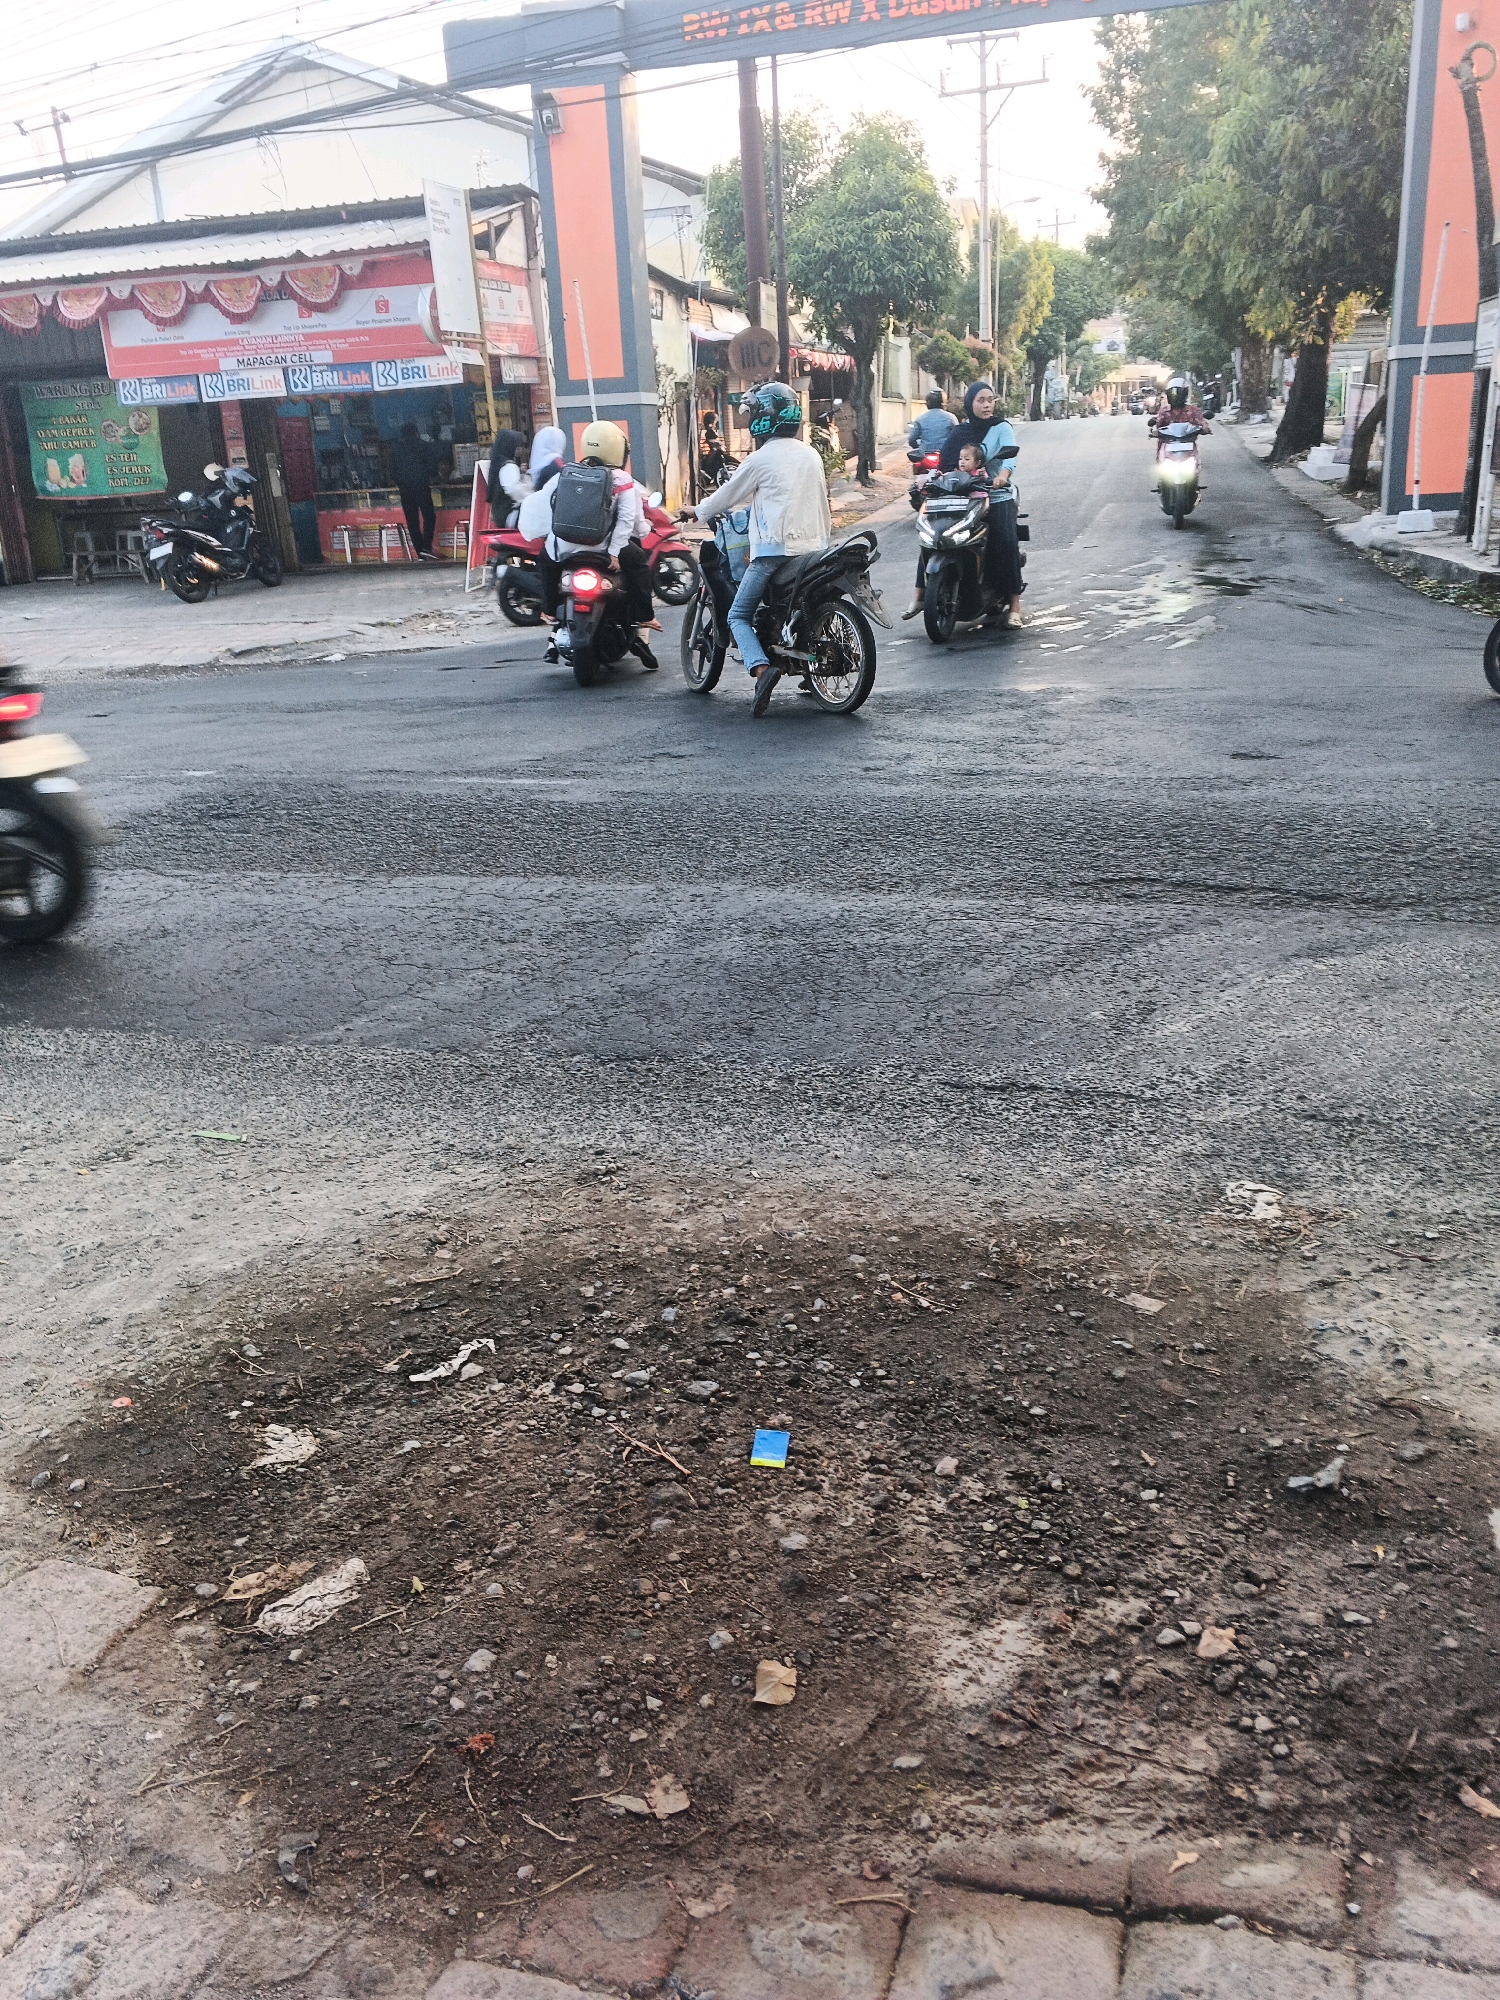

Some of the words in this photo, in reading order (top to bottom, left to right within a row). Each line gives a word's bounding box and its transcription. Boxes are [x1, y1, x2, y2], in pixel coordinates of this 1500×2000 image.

[804, 0, 851, 26] RW
[236, 354, 288, 368] MAPAGAN
[290, 352, 314, 364] CELL
[312, 369, 372, 387] BRILink
[401, 361, 459, 381] BRILink
[34, 382, 88, 399] WARUNG
[142, 381, 197, 399] BRILink
[227, 374, 283, 393] BRILink
[61, 439, 97, 449] CAMPUR
[105, 454, 117, 463] ES
[118, 453, 138, 462] TEH
[106, 466, 118, 475] ES
[120, 465, 152, 474] JERUK
